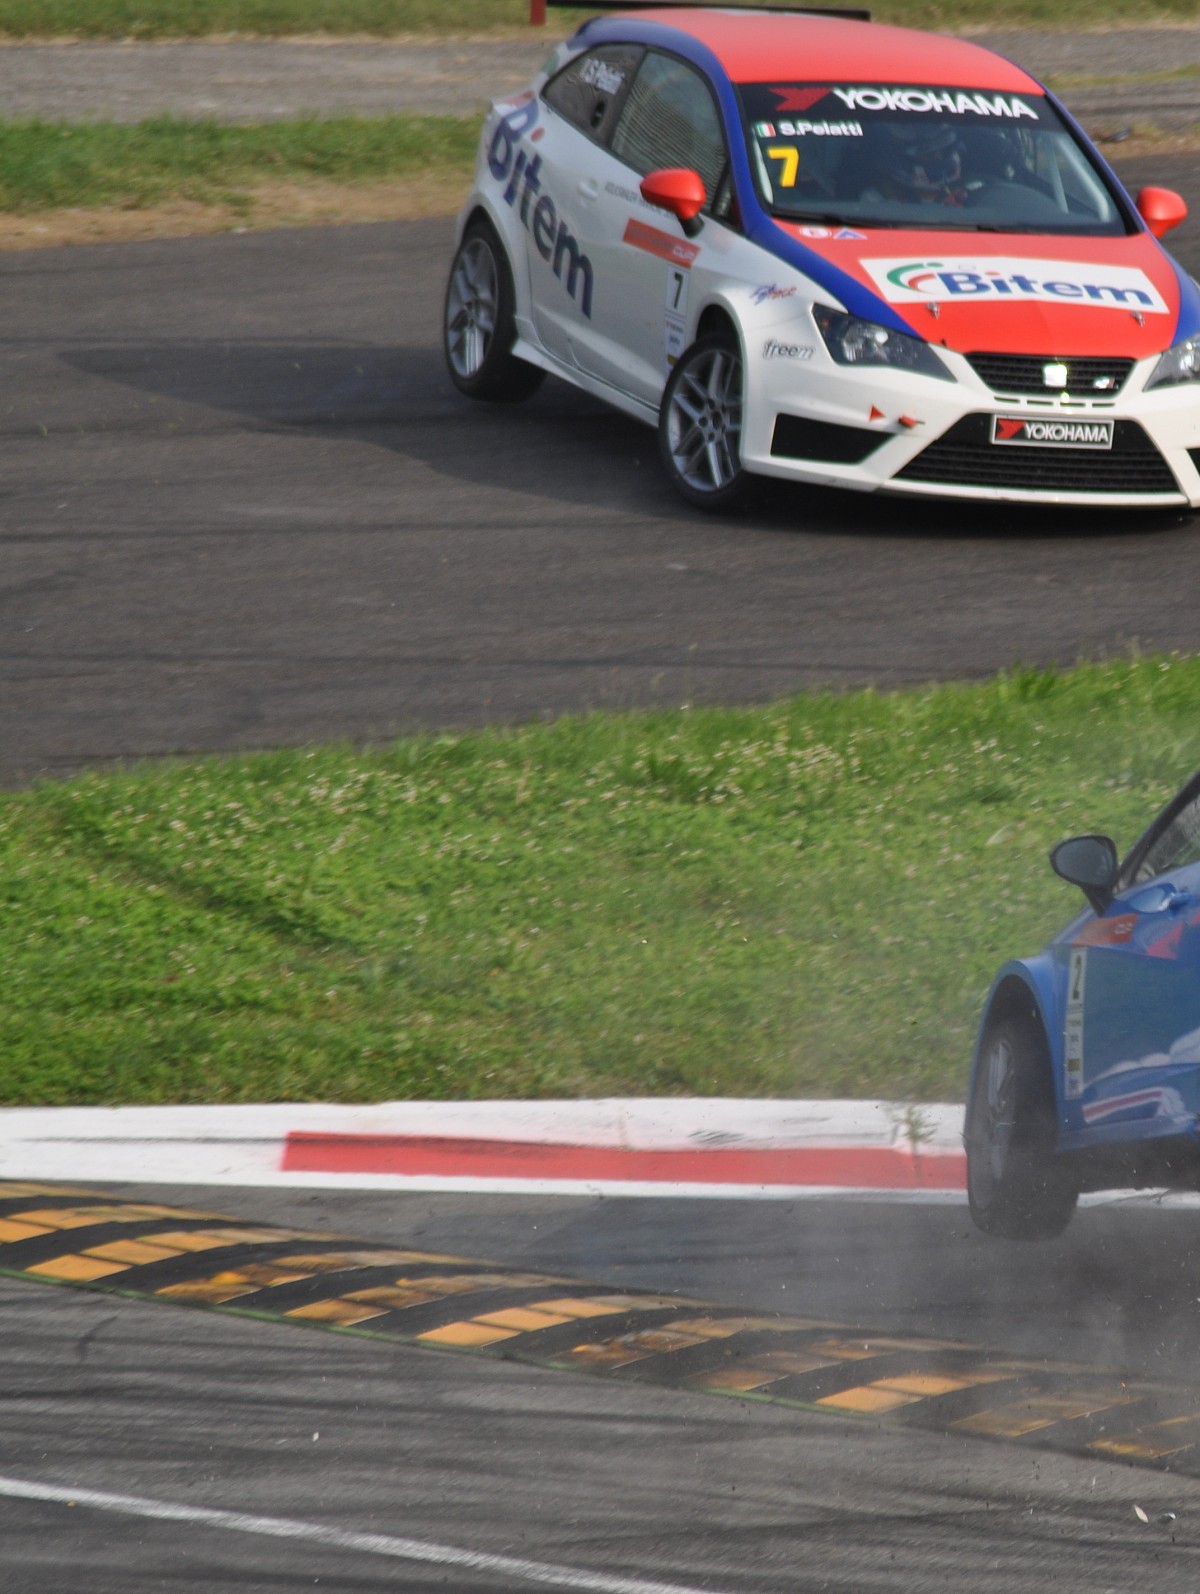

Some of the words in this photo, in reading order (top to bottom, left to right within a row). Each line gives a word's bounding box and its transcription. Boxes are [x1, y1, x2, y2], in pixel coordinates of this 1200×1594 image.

[832, 87, 1039, 121] YOKOHAMA
[767, 146, 799, 188] 7
[486, 98, 595, 321] Bitem
[673, 271, 684, 309] 7
[936, 270, 1154, 306] Bitem
[1025, 422, 1109, 442] YOKOHAMA
